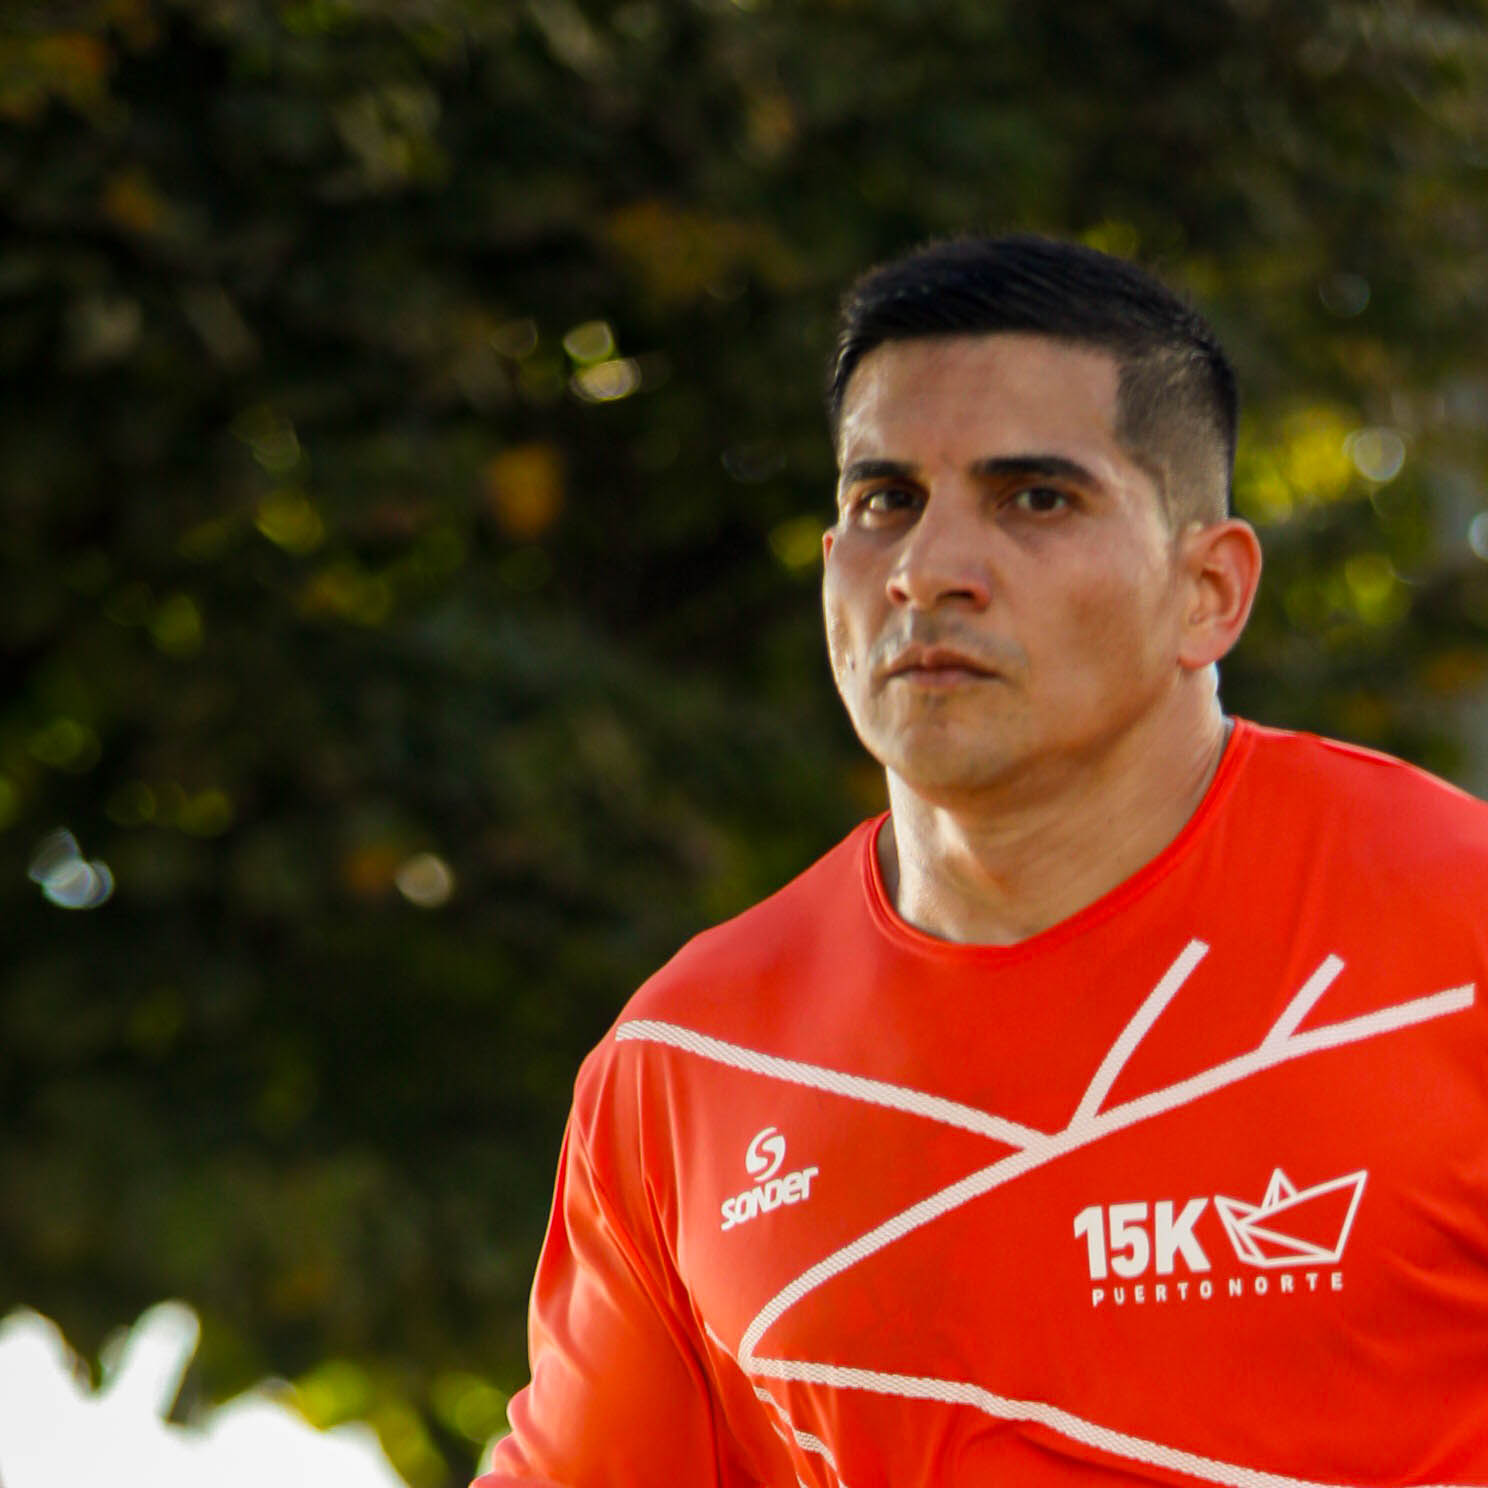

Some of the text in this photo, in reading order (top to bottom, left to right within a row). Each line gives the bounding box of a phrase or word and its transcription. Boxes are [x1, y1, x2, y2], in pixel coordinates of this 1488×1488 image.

[1073, 1197, 1211, 1280] 15K
[1092, 1272, 1344, 1307] PUERTO NORTE
